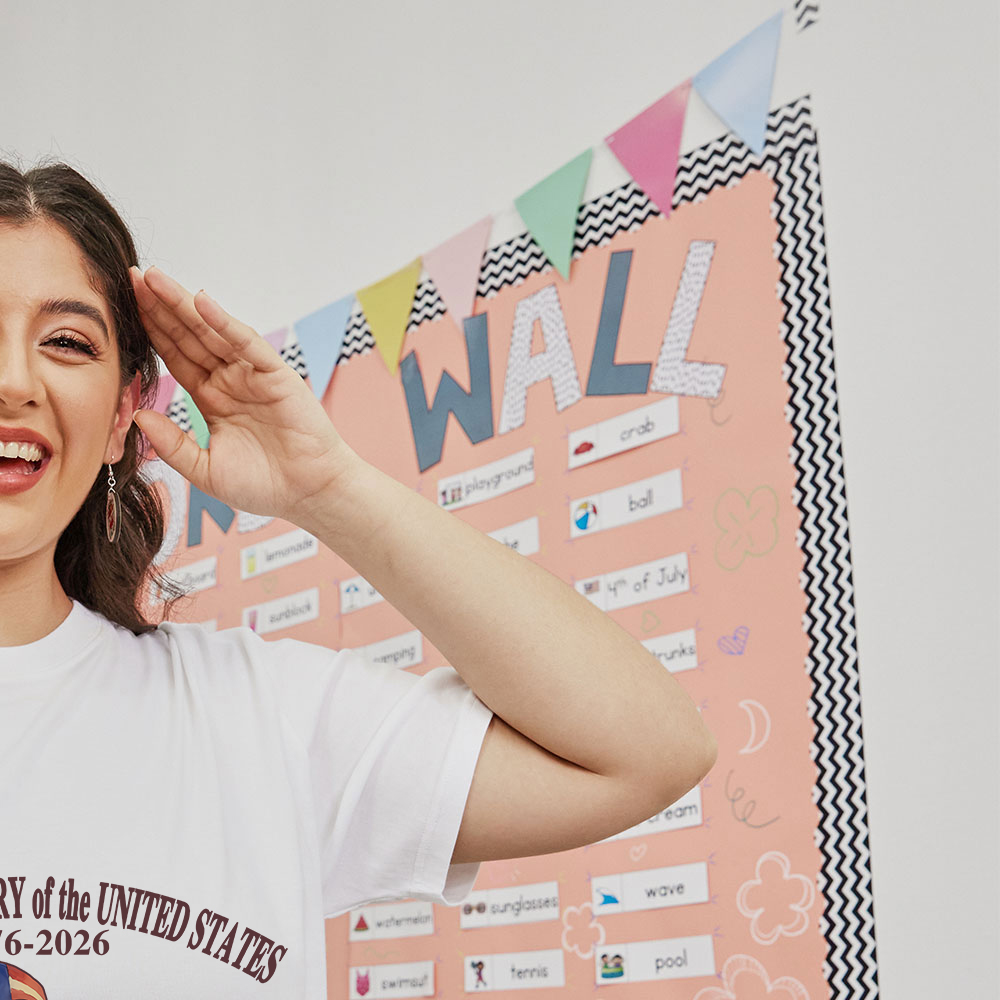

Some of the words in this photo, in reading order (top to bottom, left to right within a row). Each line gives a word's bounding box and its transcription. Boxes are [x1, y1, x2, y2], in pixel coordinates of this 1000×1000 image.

[400, 238, 727, 473] WALL
[619, 416, 656, 442] crab
[465, 459, 535, 497] playground
[628, 488, 654, 512] ball
[264, 537, 314, 563] lemonade
[633, 571, 650, 593] of
[656, 564, 688, 587] July
[269, 602, 312, 624] sunblock
[645, 880, 686, 900] wave
[489, 895, 560, 918] sunglasses
[31, 874, 56, 921] of
[57, 876, 92, 923] the
[96, 880, 191, 943] UNITED
[186, 907, 289, 985] STATES
[374, 911, 434, 930] watermelon
[510, 963, 550, 981] tennis
[654, 948, 689, 974] pool
[380, 973, 430, 991] swimsuit
